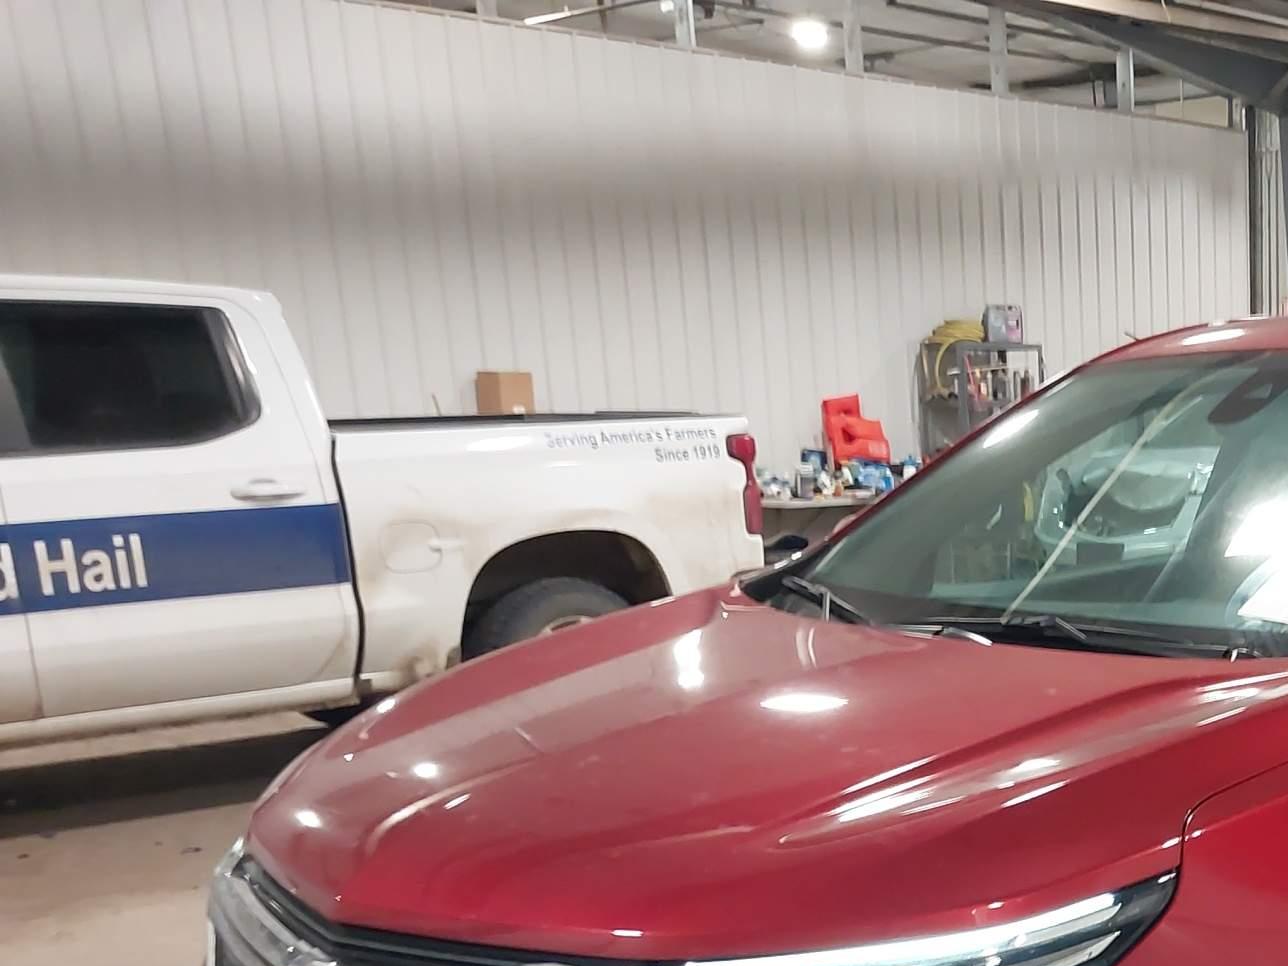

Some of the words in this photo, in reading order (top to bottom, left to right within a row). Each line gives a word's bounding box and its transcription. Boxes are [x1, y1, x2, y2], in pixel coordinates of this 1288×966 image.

[544, 431, 599, 449] Serving
[600, 429, 663, 444] America's
[665, 427, 717, 440] Farmers
[654, 448, 689, 463] Since
[693, 445, 721, 461] 1919
[33, 532, 149, 597] Hail
